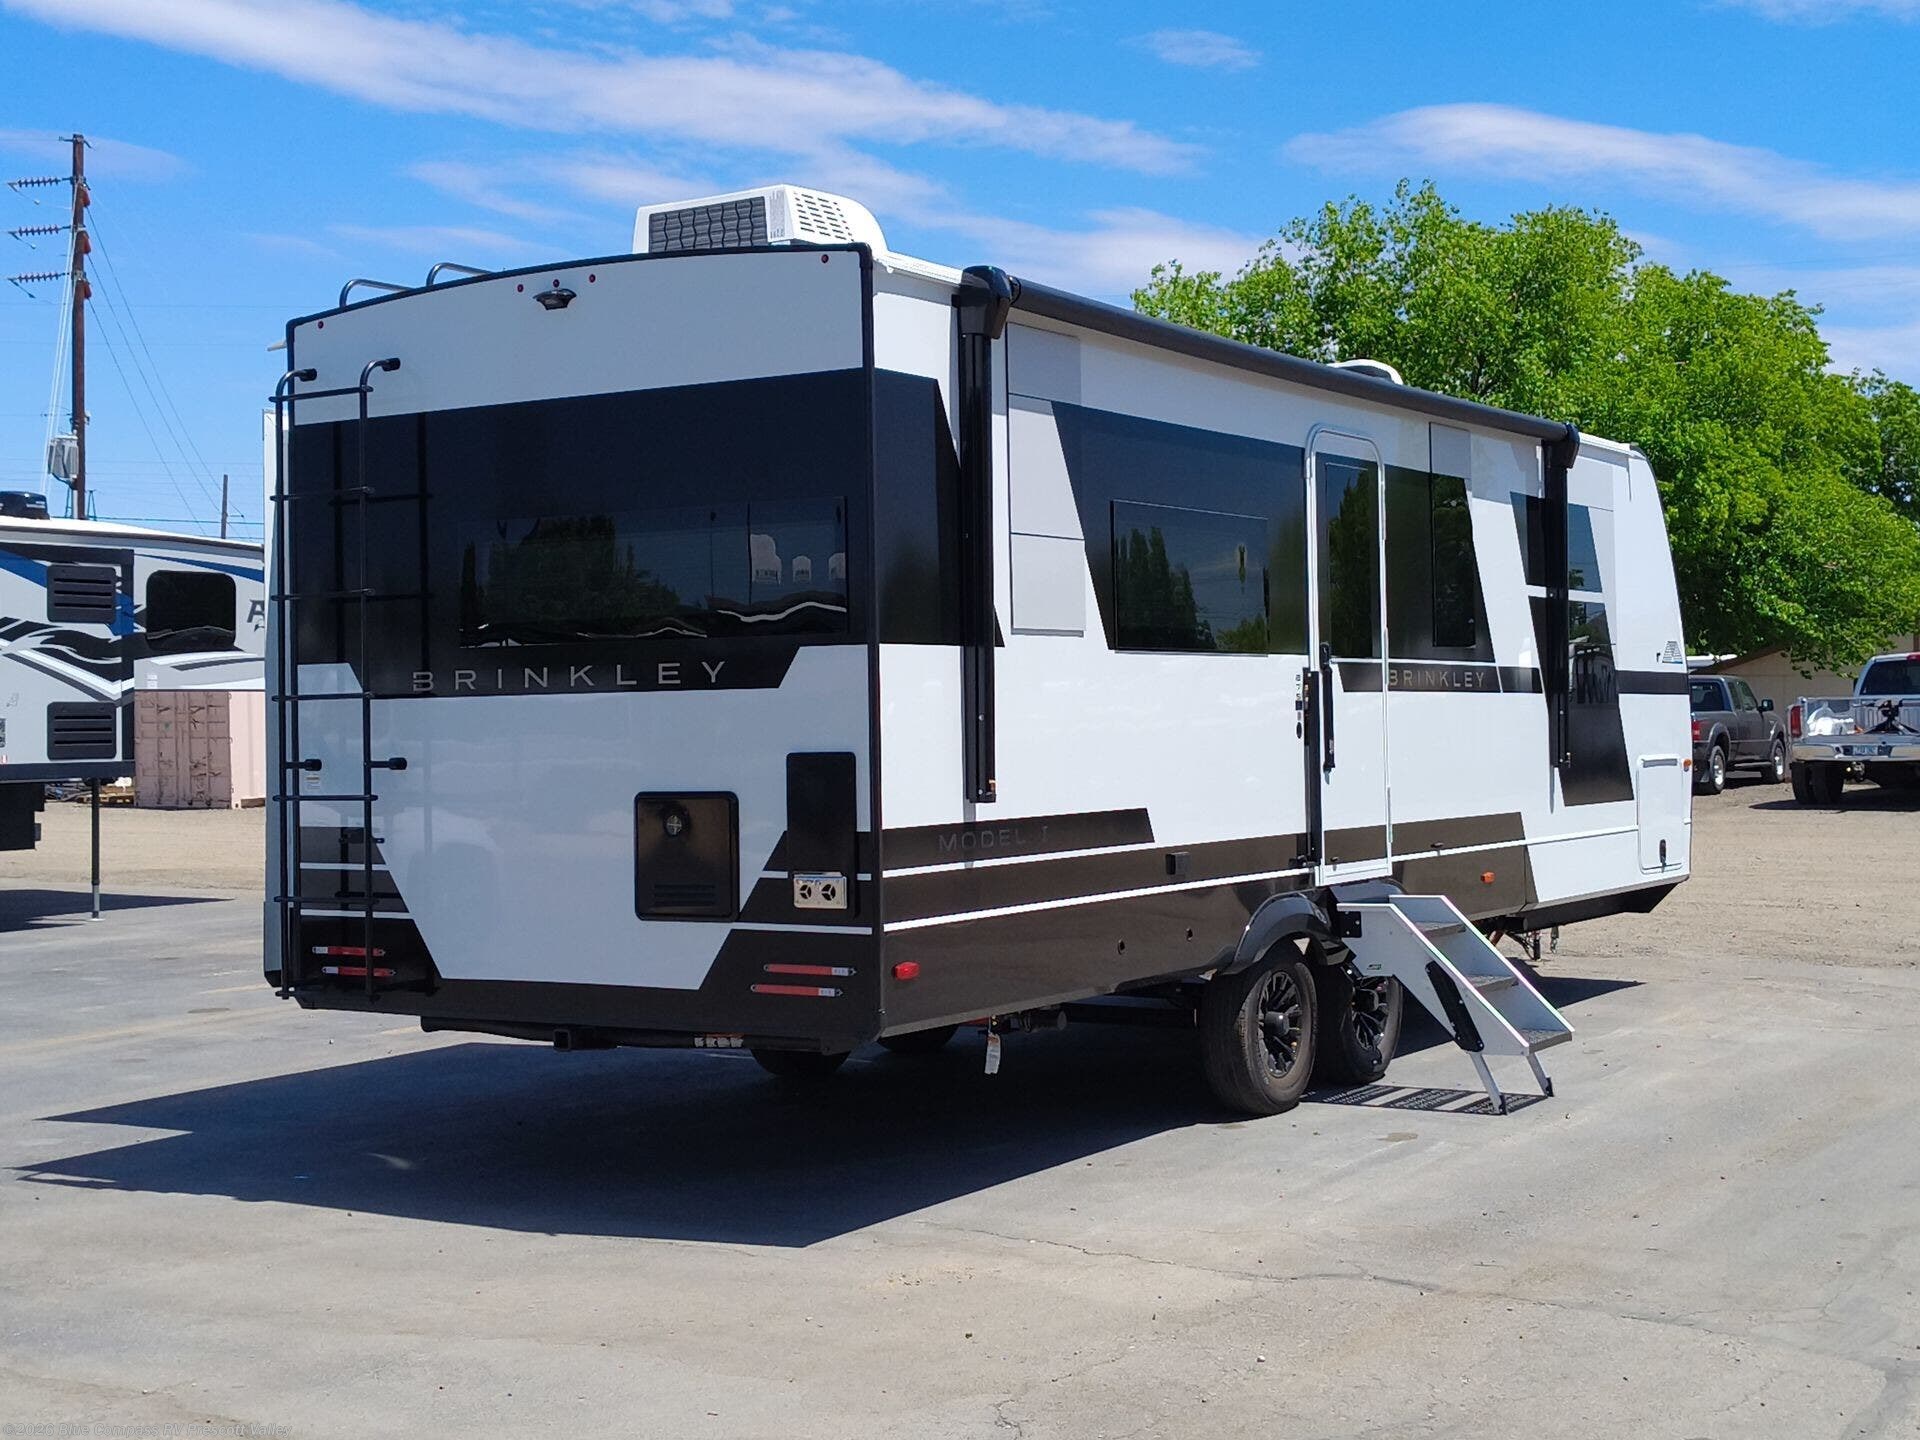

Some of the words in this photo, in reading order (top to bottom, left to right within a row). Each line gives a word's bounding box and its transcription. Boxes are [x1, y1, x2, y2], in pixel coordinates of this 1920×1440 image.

[412, 661, 725, 692] BRINKLEY
[1389, 669, 1485, 688] BRINKLEY
[938, 828, 1027, 852] MODEL
